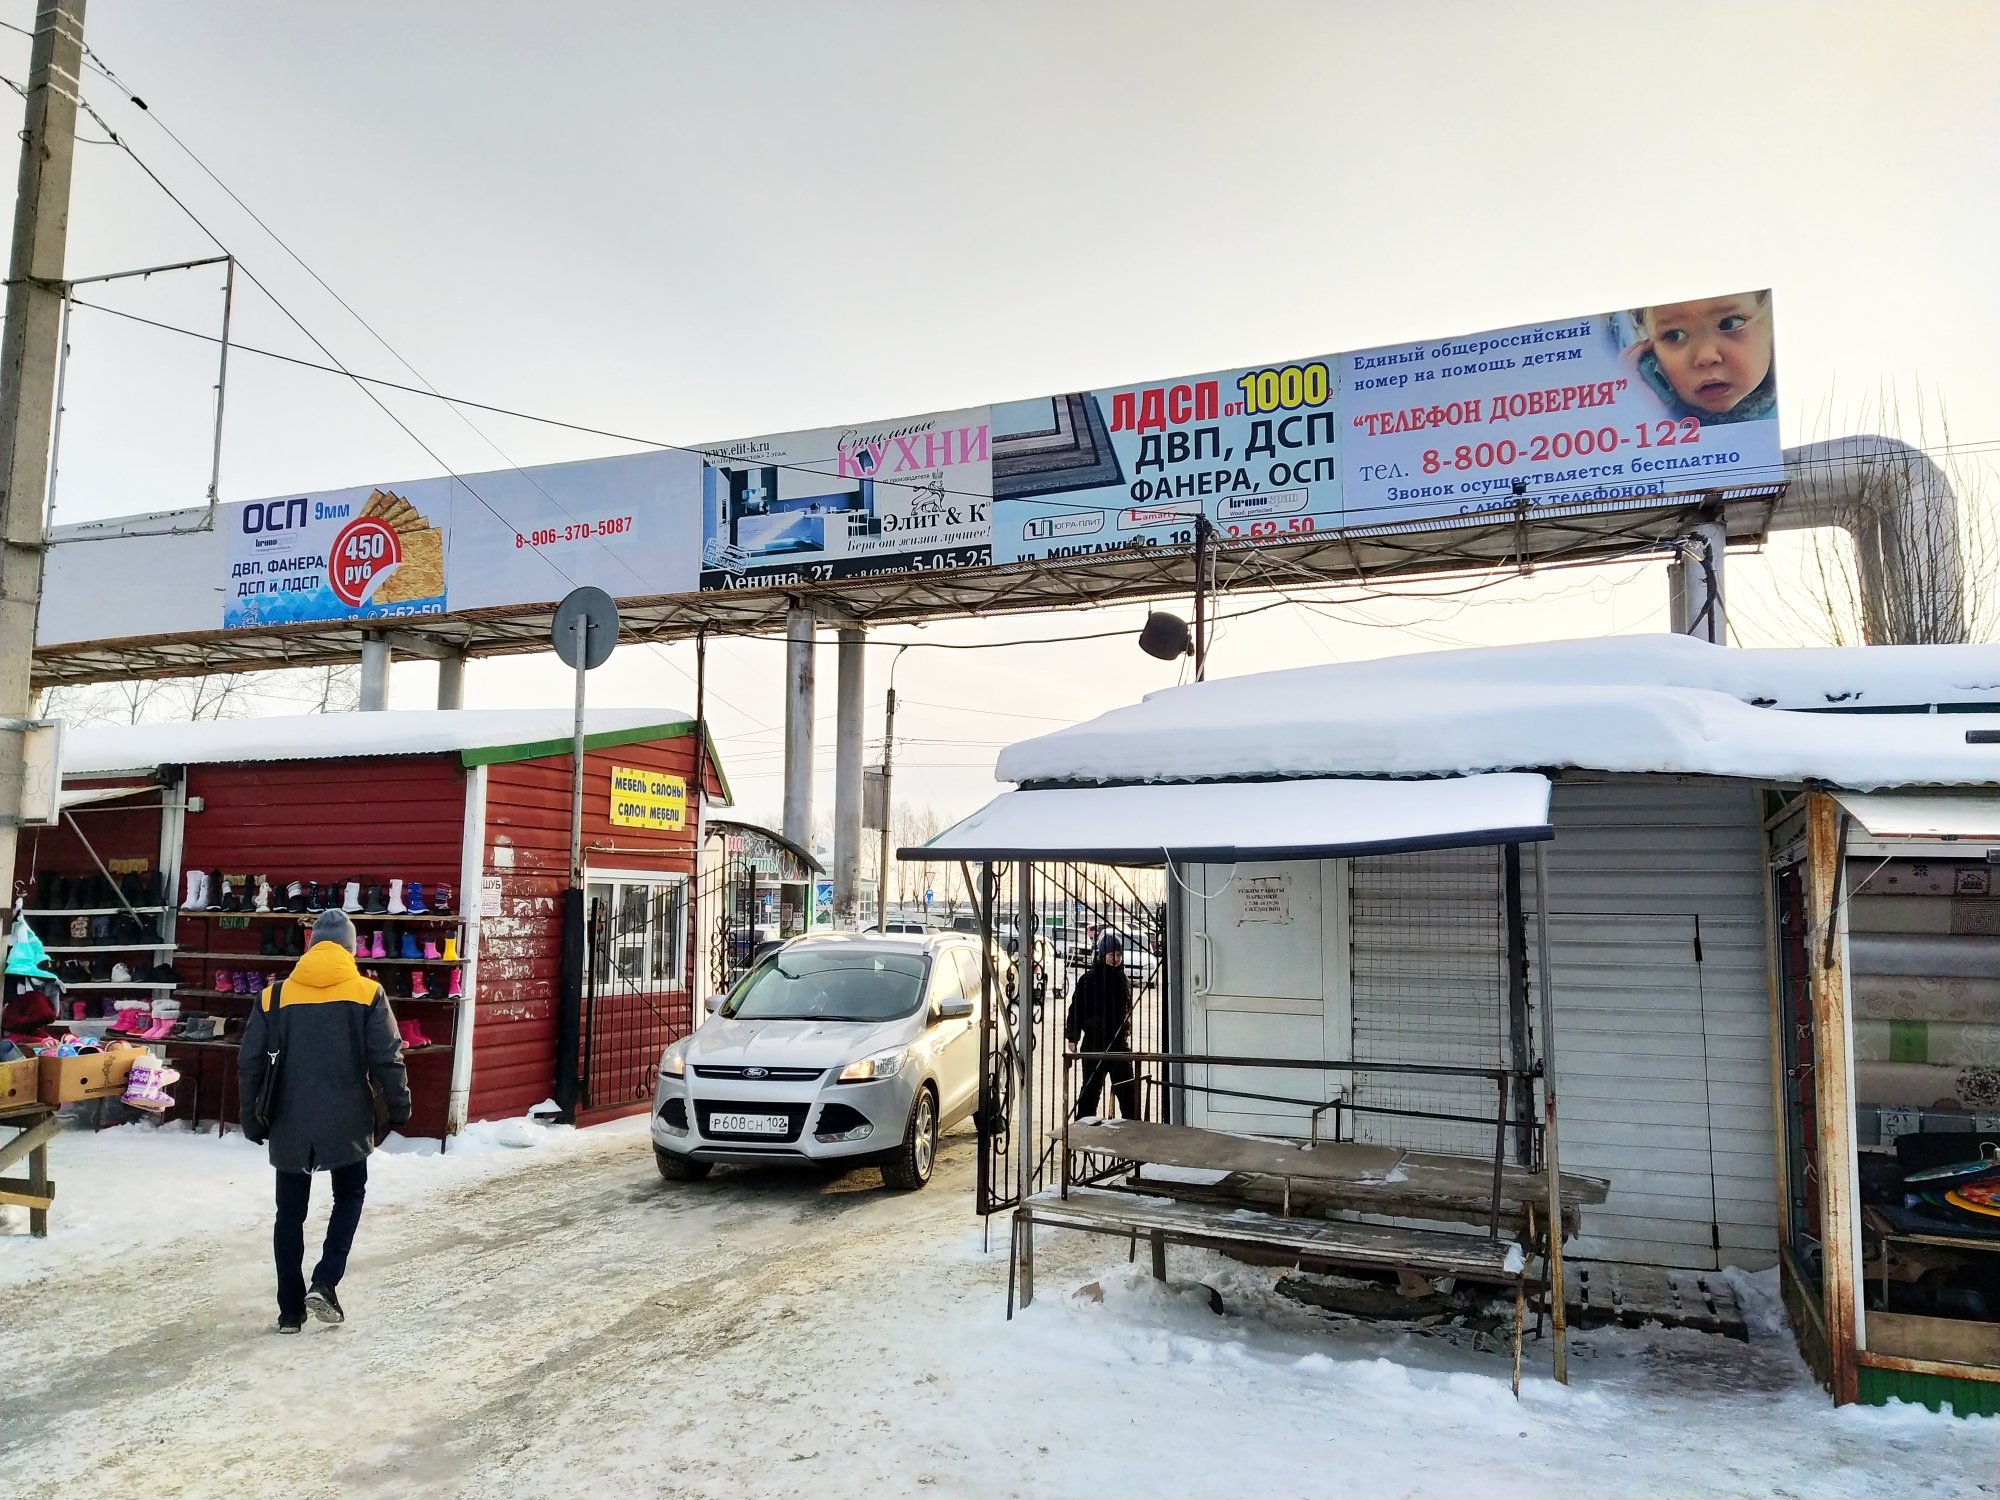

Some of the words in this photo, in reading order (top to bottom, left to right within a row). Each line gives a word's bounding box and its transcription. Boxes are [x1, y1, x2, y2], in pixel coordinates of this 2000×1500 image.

[1354, 347, 1425, 370] Единый
[1431, 322, 1591, 359] общероссийский
[1354, 374, 1408, 391] номер
[1414, 371, 1435, 382] на
[1441, 359, 1516, 379] помощь
[1522, 348, 1582, 368] детям
[1110, 380, 1218, 435] ЛДСП
[1224, 401, 1243, 417] от
[1237, 362, 1329, 416] 1000
[838, 420, 936, 451] Стильные
[1135, 426, 1233, 475] ДВП,
[1245, 411, 1334, 462] ДСП
[1359, 463, 1409, 482] тел.
[1422, 416, 1700, 475] 8-800-2000-122
[704, 441, 770, 459] www.elit-k.ru
[837, 424, 990, 479] КУХНИ
[1130, 467, 1260, 503] ФАНЕРА,
[1269, 457, 1334, 486] ОСП
[1387, 483, 1454, 501] Звонок
[1460, 463, 1624, 495] осуществляется
[1631, 452, 1740, 473] бесплатно
[1476, 496, 1541, 512] любх
[1548, 480, 1664, 504] телефонов!
[243, 498, 308, 534] ОСП
[314, 502, 350, 520] 9мм
[883, 513, 940, 532] Элит
[945, 506, 963, 525] &
[1054, 518, 1102, 530] ЮГРА-ПЛИТ
[1131, 508, 1178, 523] Lamarty
[516, 516, 632, 549] 8-906-370-5087
[847, 538, 875, 554] Бери
[878, 540, 896, 549] от
[898, 535, 938, 547] жизни
[940, 526, 991, 544] лучшее!
[1227, 517, 1315, 546] 2-62-50
[345, 533, 384, 560] 450
[912, 549, 991, 571] 5-05-25
[232, 561, 263, 578] ДВП,
[268, 555, 327, 573] ФАНЕРА,
[344, 560, 371, 585] руб
[810, 564, 834, 580] 27
[237, 581, 265, 597] ДСП
[269, 582, 277, 593] и
[282, 576, 319, 593] ЛДСП
[615, 777, 646, 793] МЕБЕЛЬ
[651, 782, 683, 798] САЛОНЫ
[618, 802, 646, 818] САЛОН
[650, 806, 679, 821] МЕБЕЛИ
[767, 1117, 785, 1128] 102
